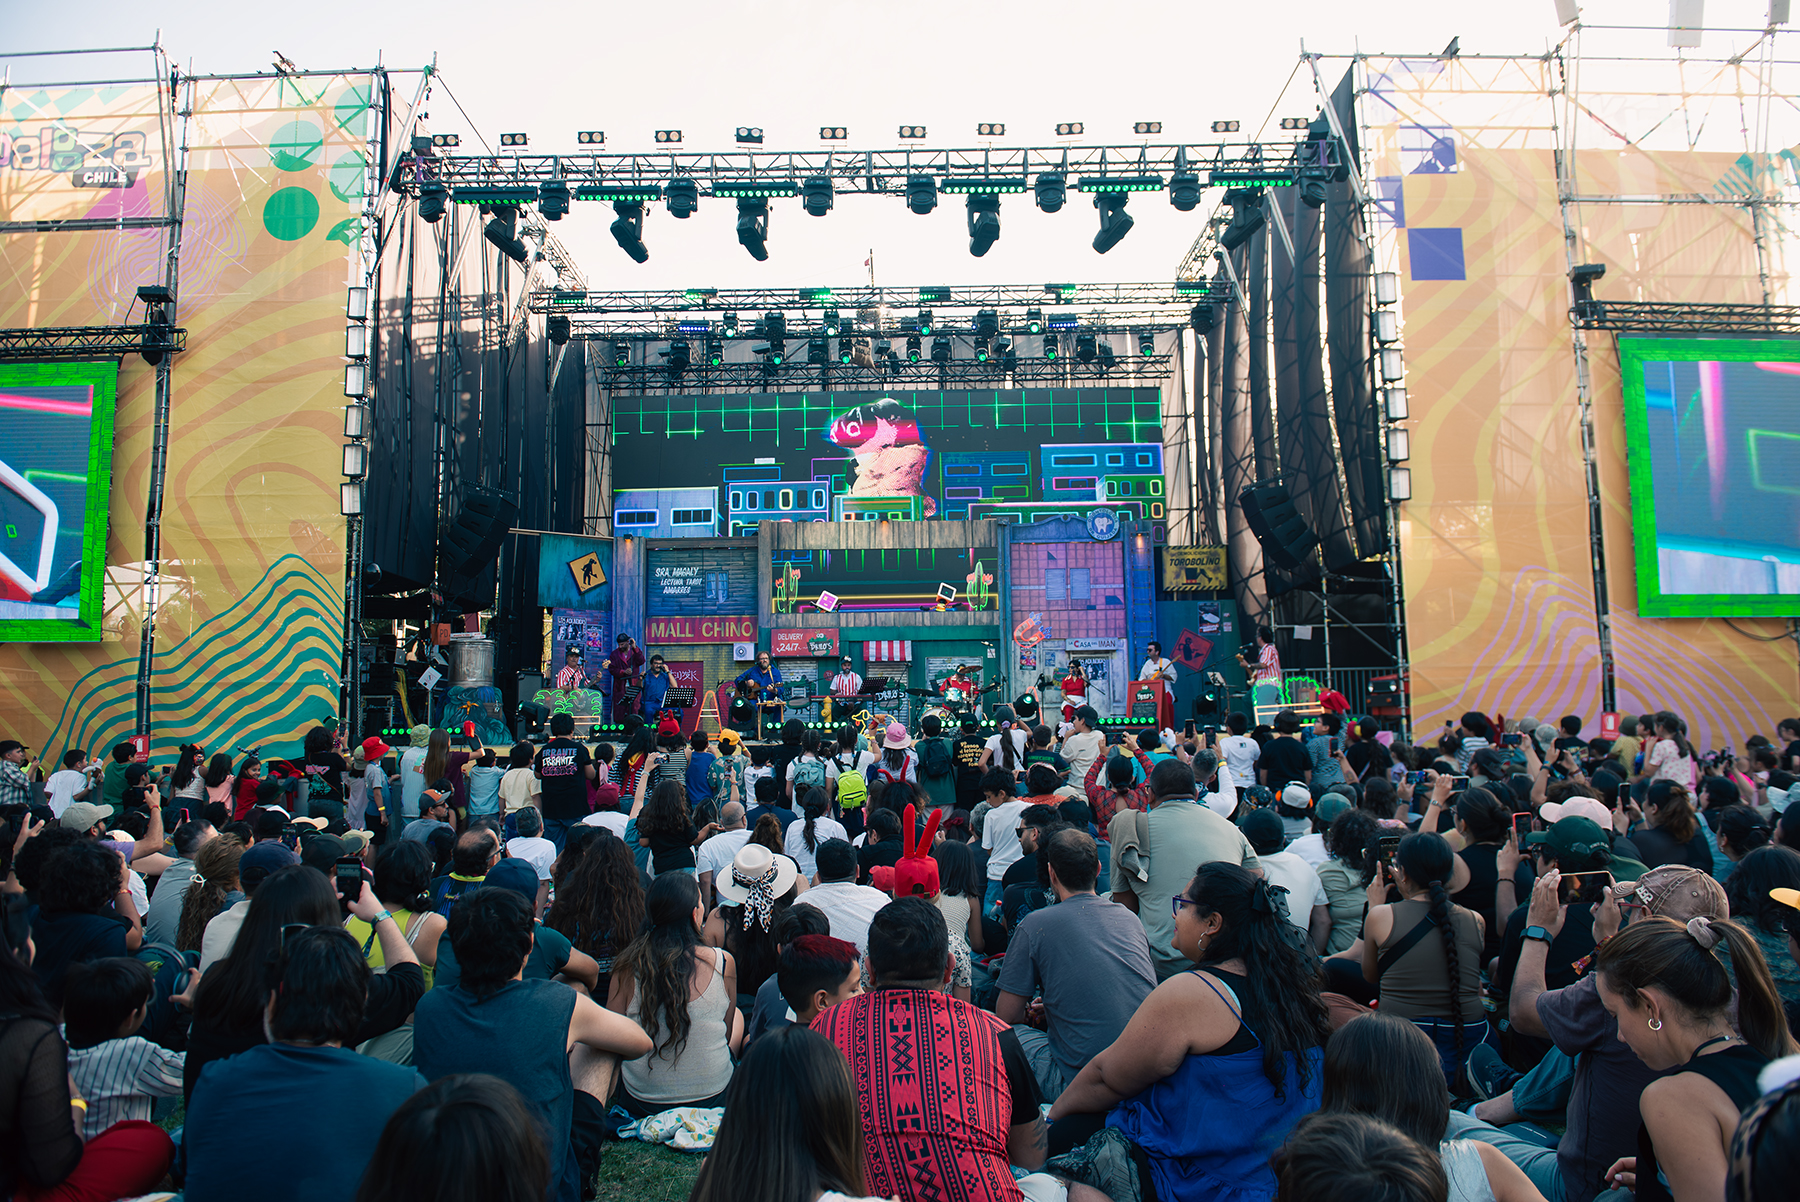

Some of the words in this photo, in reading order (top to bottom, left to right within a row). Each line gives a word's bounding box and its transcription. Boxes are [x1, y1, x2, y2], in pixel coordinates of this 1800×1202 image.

[83, 172, 128, 184] CHILE
[1169, 557, 1221, 567] TOROBOLINO
[671, 567, 700, 577] MAGALY
[660, 578, 684, 586] LECTURA
[686, 578, 703, 586] TAROT
[663, 586, 692, 595] AMARRES
[651, 622, 694, 638] MALL
[702, 621, 754, 638] CHINO
[777, 633, 804, 641] DELIVERY
[779, 642, 799, 652] 24/7
[1074, 640, 1092, 648] CASA
[542, 748, 577, 757] ERRANTE
[542, 755, 576, 767] ERRANTE
